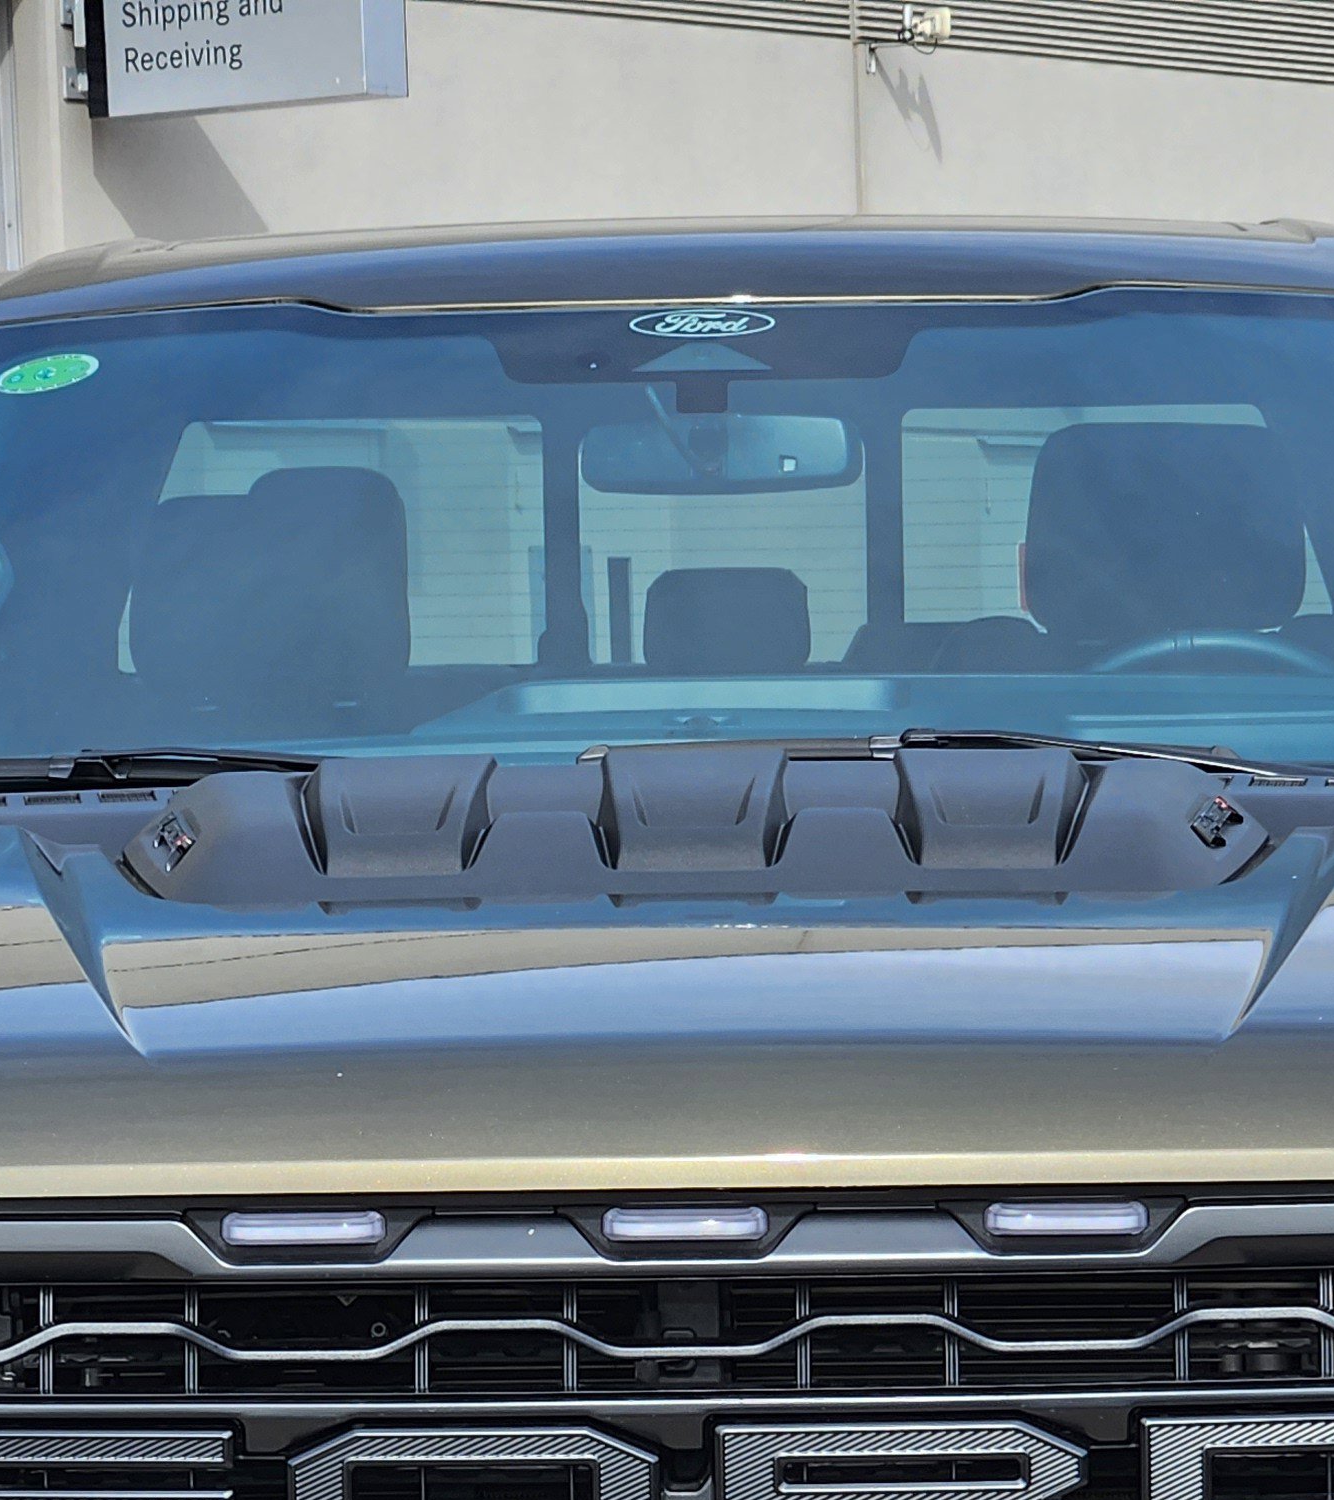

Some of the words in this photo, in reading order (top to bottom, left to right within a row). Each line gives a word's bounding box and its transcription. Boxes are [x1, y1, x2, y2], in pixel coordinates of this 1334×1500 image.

[122, 0, 230, 31] Shipping
[124, 39, 243, 73] Receiving
[655, 313, 750, 333] Ford
